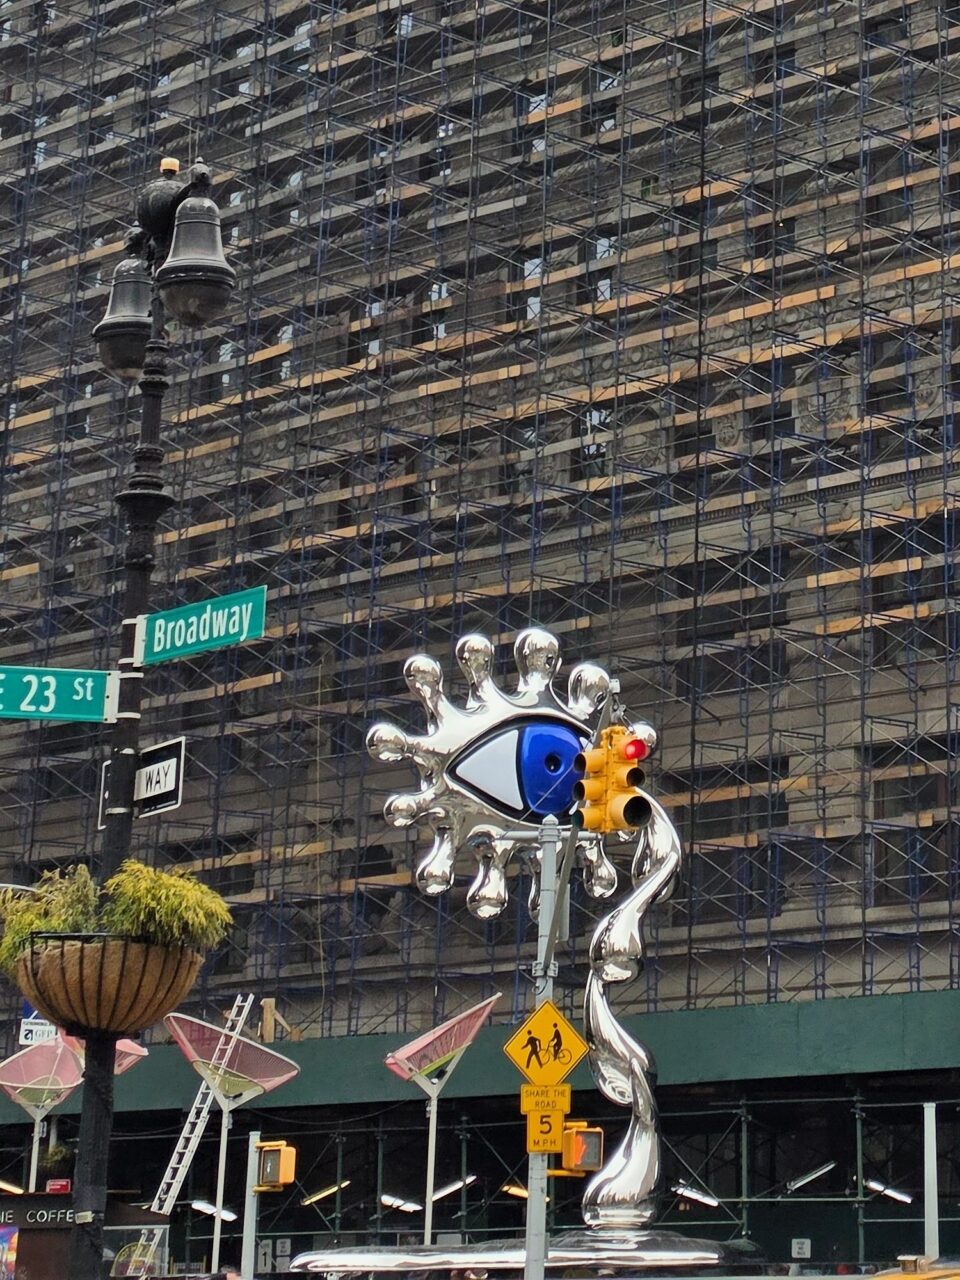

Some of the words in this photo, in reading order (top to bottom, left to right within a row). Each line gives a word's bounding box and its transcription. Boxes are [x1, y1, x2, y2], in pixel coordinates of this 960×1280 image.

[153, 602, 253, 653] Broadway
[19, 674, 57, 713] 23
[72, 677, 95, 701] St
[145, 764, 171, 795] WAY
[524, 1089, 551, 1098] SHARE
[553, 1088, 567, 1098] THE
[534, 1100, 557, 1109] ROAD
[539, 1114, 553, 1135] 5
[26, 1209, 75, 1223] COFFE
